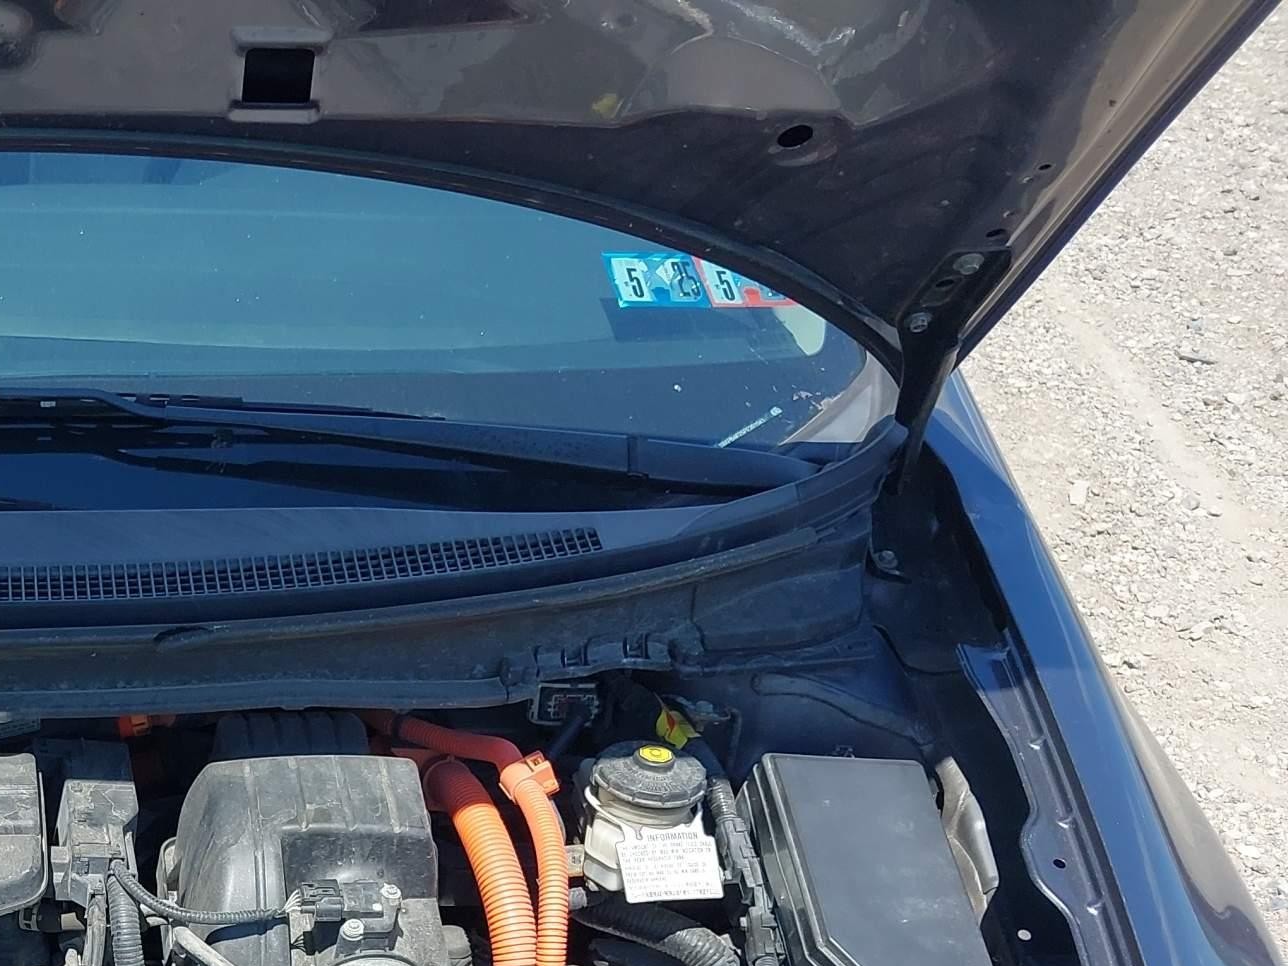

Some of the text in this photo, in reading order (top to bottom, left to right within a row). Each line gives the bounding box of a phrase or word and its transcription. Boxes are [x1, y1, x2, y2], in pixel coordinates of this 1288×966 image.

[626, 267, 645, 298] 5
[715, 270, 736, 301] 5
[647, 832, 698, 842] INFORMATION
